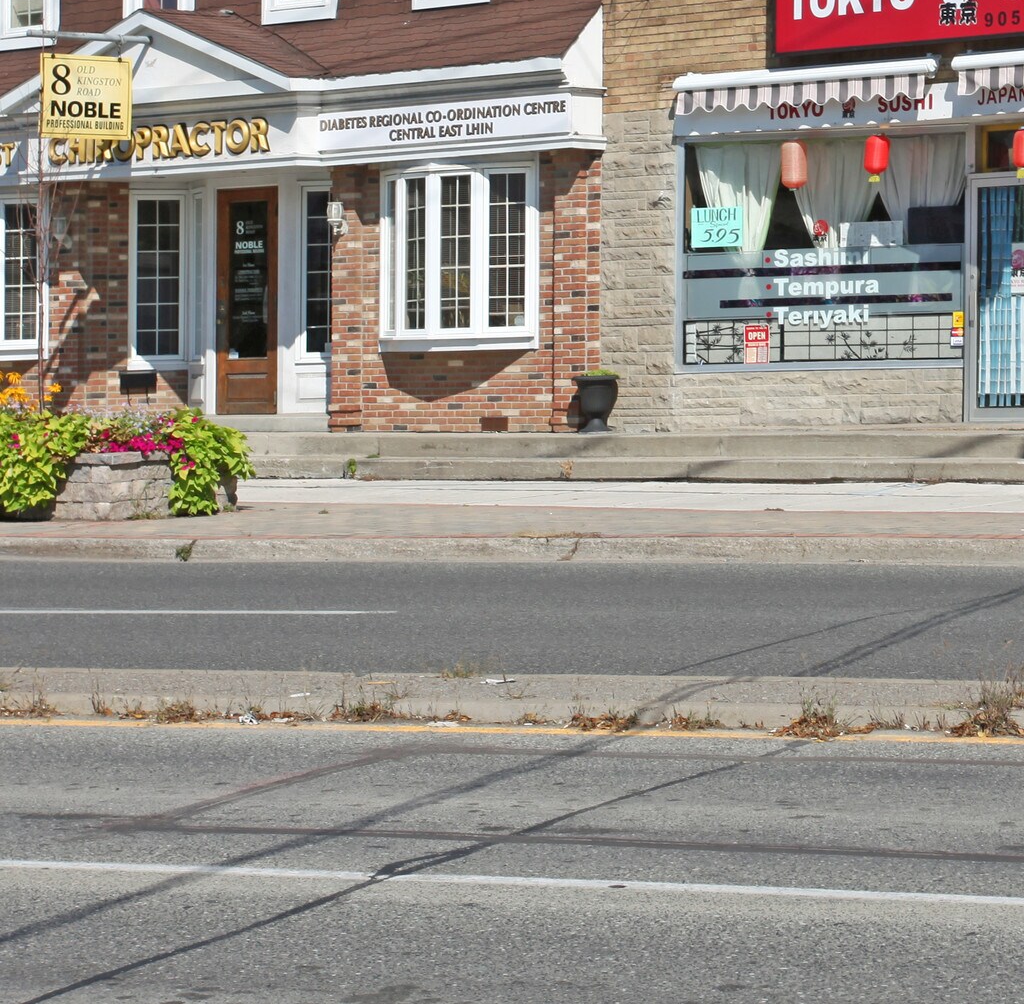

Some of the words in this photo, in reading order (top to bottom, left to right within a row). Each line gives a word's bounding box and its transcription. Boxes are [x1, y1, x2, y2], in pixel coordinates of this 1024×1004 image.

[51, 64, 71, 95] 8
[76, 65, 95, 75] OLD
[76, 76, 122, 87] KINGSTON
[76, 87, 102, 97] ROAD
[50, 100, 121, 119] NOBLE
[320, 116, 368, 132] DIABETES
[369, 111, 424, 128] REGIONAL
[425, 103, 521, 123] CO-ORDINATION
[523, 100, 567, 115] CENTRE
[46, 119, 93, 130] PROFESSIONAL
[94, 120, 124, 131] BUILDING
[389, 125, 436, 142] CENTRAL
[439, 124, 463, 138] EAST
[466, 122, 494, 136] LHIN
[47, 116, 271, 166] CHIROPRACTOR
[696, 207, 737, 223] LUNCH
[236, 220, 245, 235] 8
[700, 228, 741, 244] 5.95
[235, 240, 263, 250] NOBLE
[773, 248, 869, 268] Sashimi
[773, 278, 880, 300] Tempura
[773, 304, 870, 329] Teriyaki
[748, 331, 766, 341] OPEN
